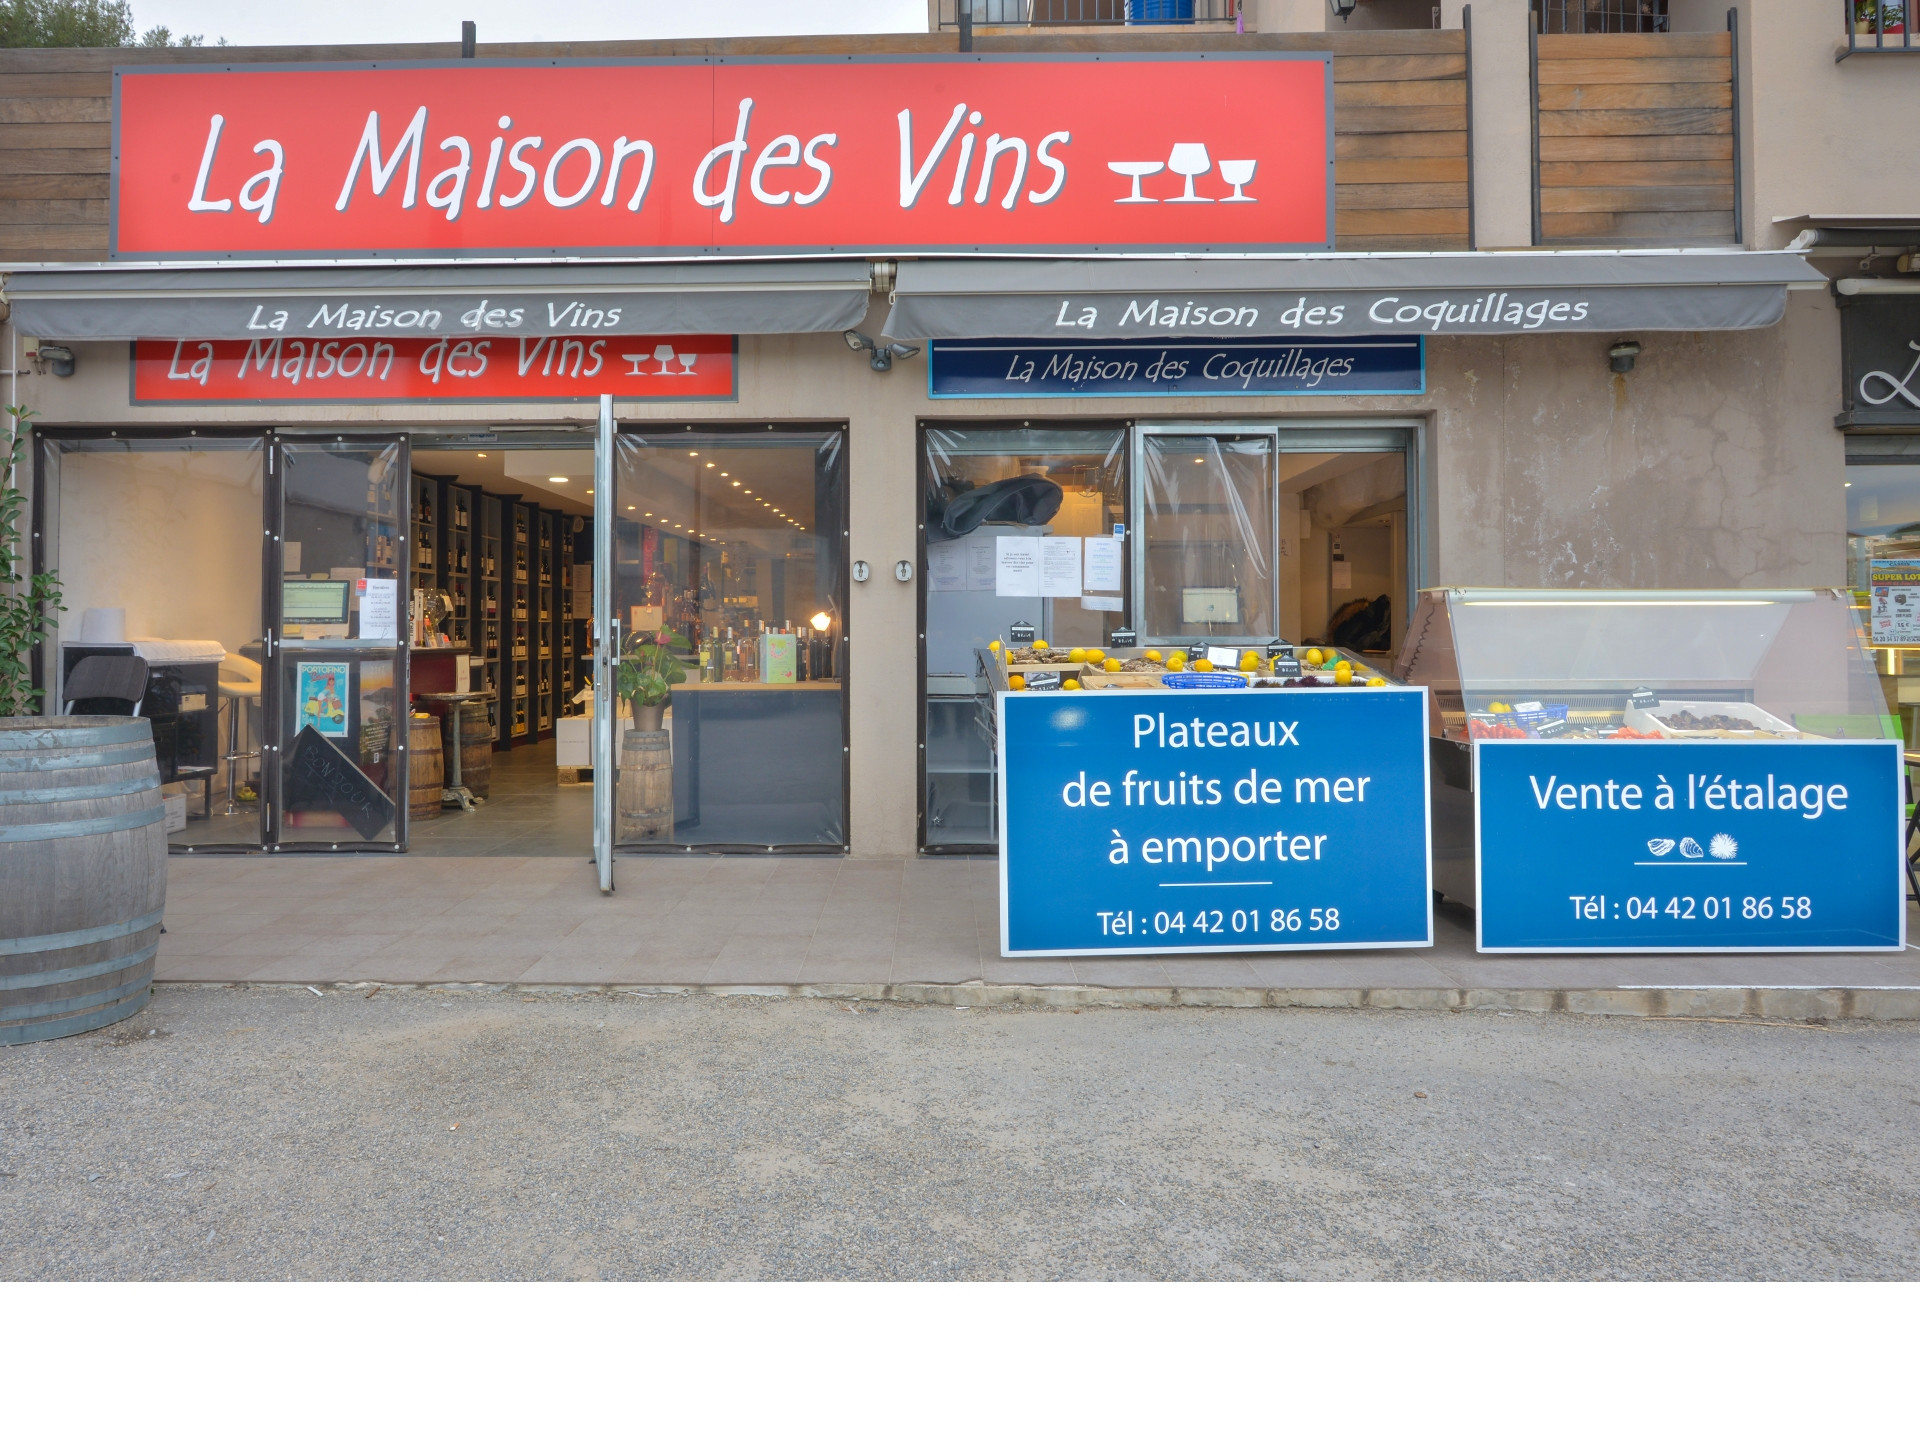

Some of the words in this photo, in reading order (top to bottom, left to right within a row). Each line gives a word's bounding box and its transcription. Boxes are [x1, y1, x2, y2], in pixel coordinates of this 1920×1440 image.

[187, 114, 284, 224] La
[335, 105, 655, 222] Maison
[692, 97, 838, 224] des
[897, 103, 1072, 210] Vins
[247, 304, 289, 333] La
[306, 302, 443, 331] Maison
[459, 298, 525, 331] des
[547, 300, 623, 329] Vins
[1055, 300, 1098, 330] La
[1118, 298, 1260, 329] Maison
[1280, 296, 1346, 329] des
[1368, 292, 1590, 331] Coquillages
[167, 338, 214, 386] La
[237, 337, 396, 386] Maison
[418, 336, 491, 384] des
[515, 336, 609, 380] Vins
[1005, 354, 1036, 383] La
[1039, 354, 1138, 383] Maison
[1144, 351, 1190, 383] des
[1203, 350, 1355, 389] Coquillages
[1872, 573, 1903, 581] SUPER
[302, 665, 346, 674] PORTOFINO
[1133, 712, 1300, 749] Plateaux
[1062, 771, 1111, 808] de
[1122, 769, 1222, 806] fruits
[1234, 768, 1282, 805] de
[1295, 776, 1372, 804] mer
[1529, 775, 1643, 811] Vente
[1654, 774, 1675, 810] à
[1108, 829, 1129, 865] à
[1141, 830, 1328, 872] emporter
[1096, 910, 1134, 935] Tél
[1154, 911, 1186, 935] 04
[1192, 910, 1224, 933] 42
[1231, 909, 1260, 933] 01
[1270, 908, 1302, 932] 86
[1309, 907, 1341, 931] 58
[1569, 895, 1606, 920] Tél
[1626, 896, 1659, 920] 04
[1664, 896, 1696, 919] 42
[1703, 896, 1732, 920] 01
[1742, 896, 1775, 919] 86
[1781, 896, 1812, 919] 58
